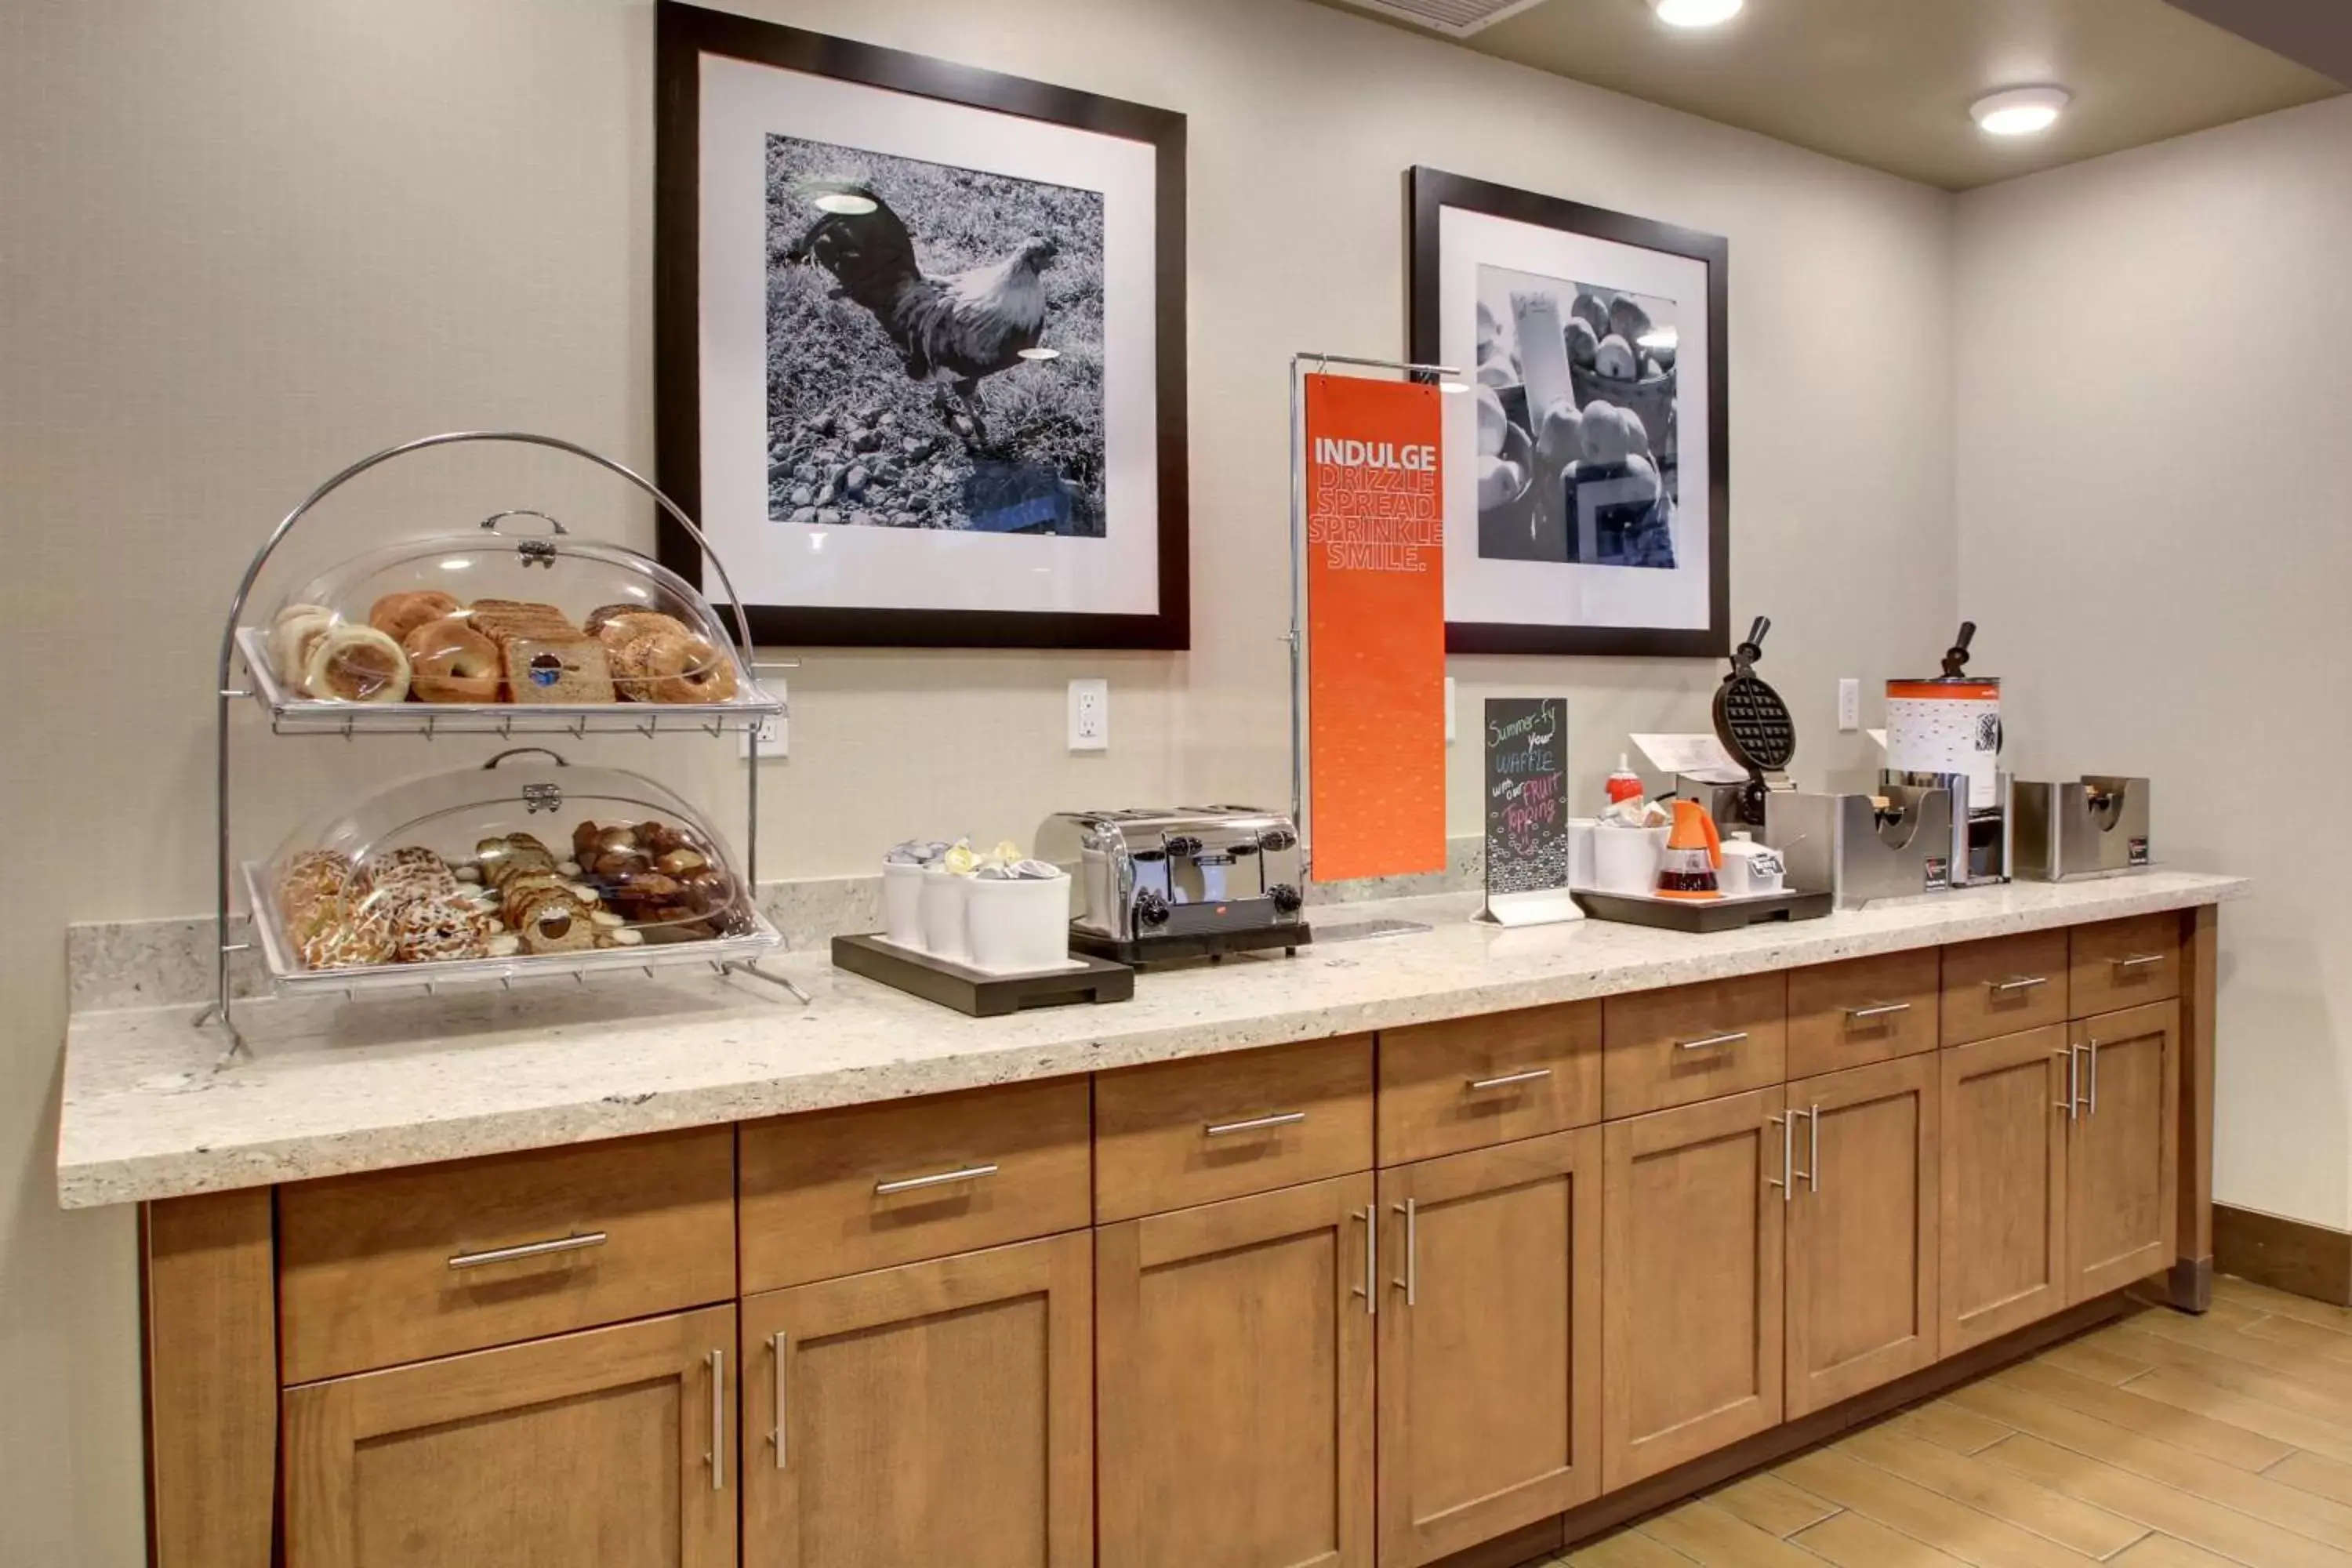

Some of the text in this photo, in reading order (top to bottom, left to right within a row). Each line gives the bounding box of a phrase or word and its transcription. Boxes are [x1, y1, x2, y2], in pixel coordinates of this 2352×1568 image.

[1315, 437, 1436, 470] INDULGE
[1319, 464, 1435, 493] DRIZZLE
[1317, 488, 1435, 519] SPREAD
[1309, 514, 1443, 546] SPRINKLE
[1327, 541, 1427, 572] SMILE.
[1496, 750, 1555, 773] WAFFLE
[1523, 771, 1563, 806] FRUIT
